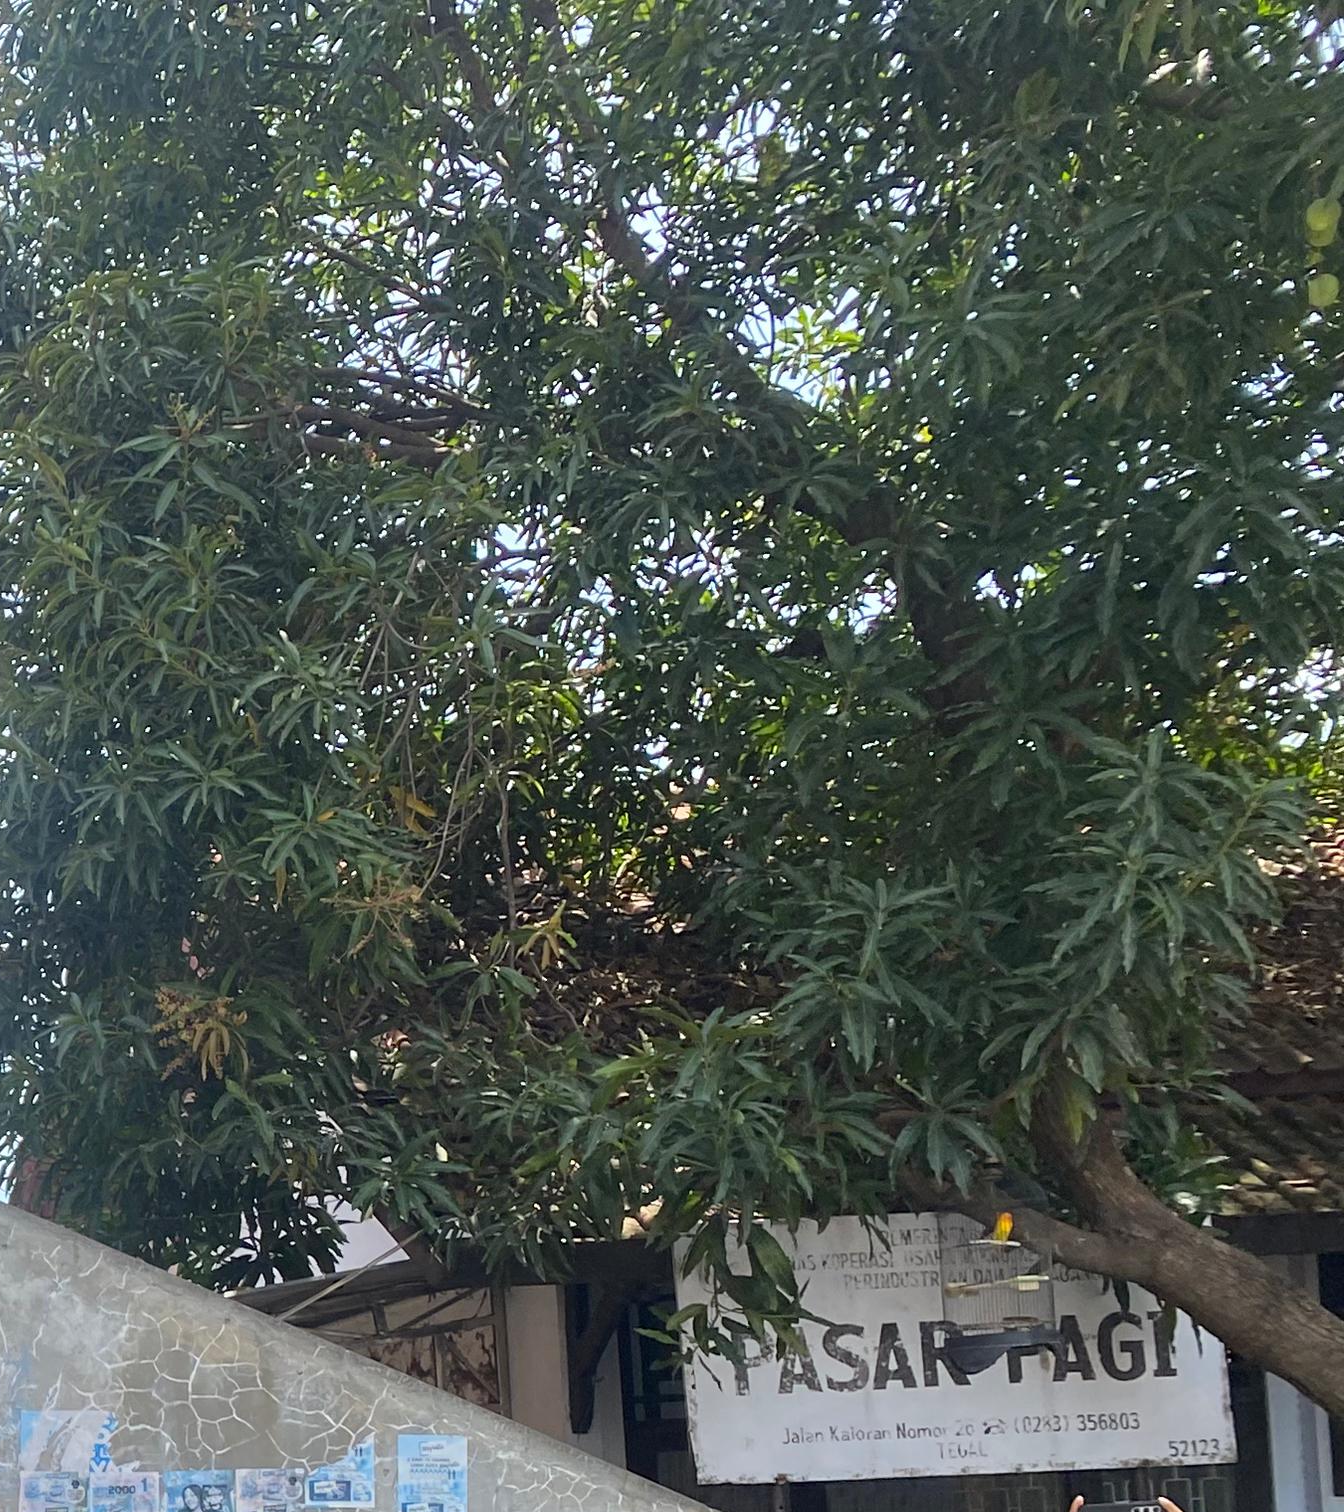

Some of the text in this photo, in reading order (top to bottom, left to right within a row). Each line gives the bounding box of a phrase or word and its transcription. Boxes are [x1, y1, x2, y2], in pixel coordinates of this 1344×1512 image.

[731, 1321, 974, 1398] PASAR
[781, 1426, 825, 1445] Jalan
[895, 1418, 949, 1440] Nomor
[1077, 1411, 1141, 1432] 356803
[1168, 1438, 1221, 1458] 52123
